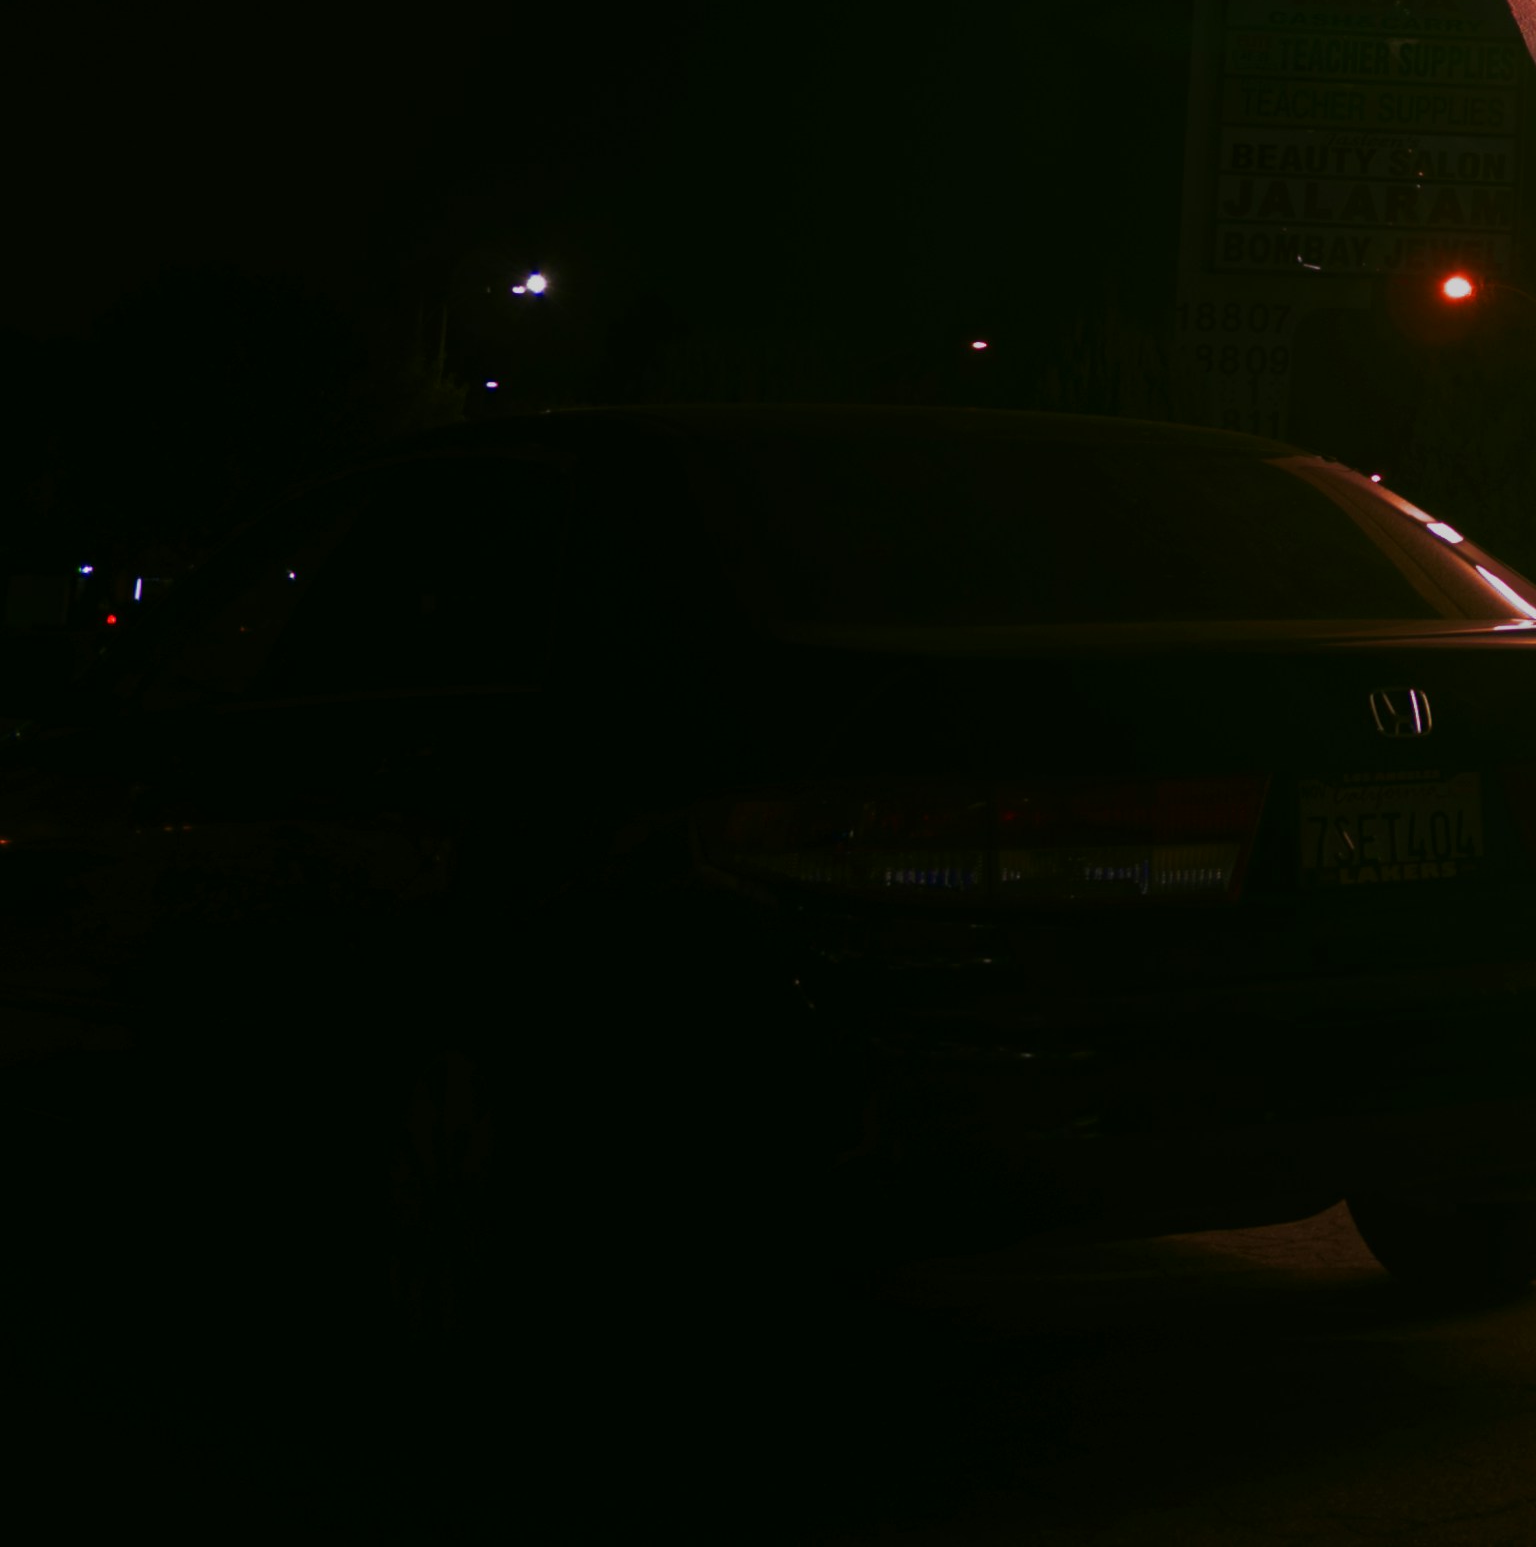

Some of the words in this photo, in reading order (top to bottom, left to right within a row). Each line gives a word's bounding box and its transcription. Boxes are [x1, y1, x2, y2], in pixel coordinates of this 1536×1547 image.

[1280, 39, 1389, 75] TEACHER
[1401, 41, 1514, 81] SUPPLIES
[1241, 87, 1366, 121] TEACHER
[1377, 93, 1505, 127] SUPPLIES
[1232, 143, 1377, 174] BEAUTY
[1388, 149, 1506, 180] SALON
[1223, 180, 1511, 226] JALARAM
[1224, 232, 1372, 267] BOMBAY
[1176, 302, 1291, 333] 18807
[1195, 344, 1290, 376] 8809
[1338, 861, 1458, 885] LAKERS
